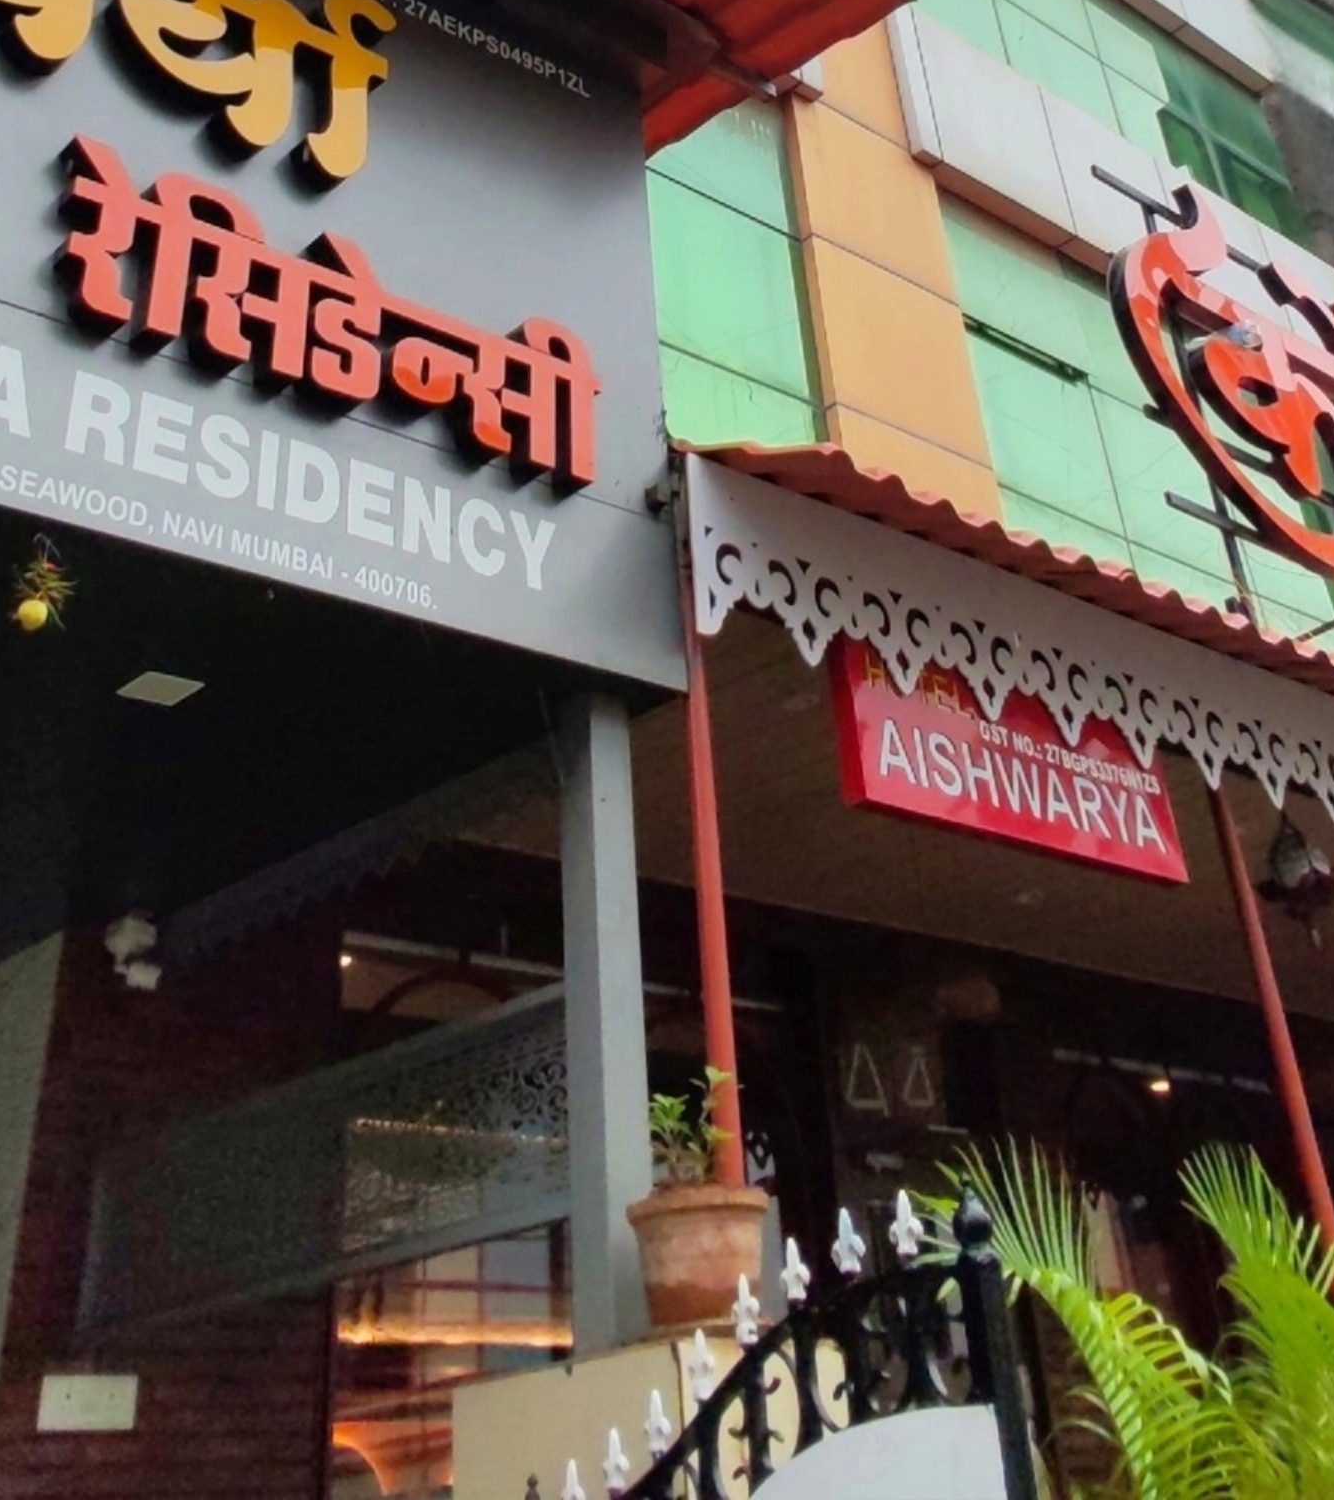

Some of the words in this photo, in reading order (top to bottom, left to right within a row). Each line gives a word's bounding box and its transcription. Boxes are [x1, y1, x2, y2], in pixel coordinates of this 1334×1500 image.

[65, 370, 556, 591] RESIDENCY
[162, 509, 223, 551] NAVI
[230, 530, 334, 581] MUMBAI
[353, 567, 439, 611] 400706.
[866, 651, 974, 719] HTEL
[978, 719, 1009, 748] GST
[878, 717, 1167, 855] AISHWARYA
